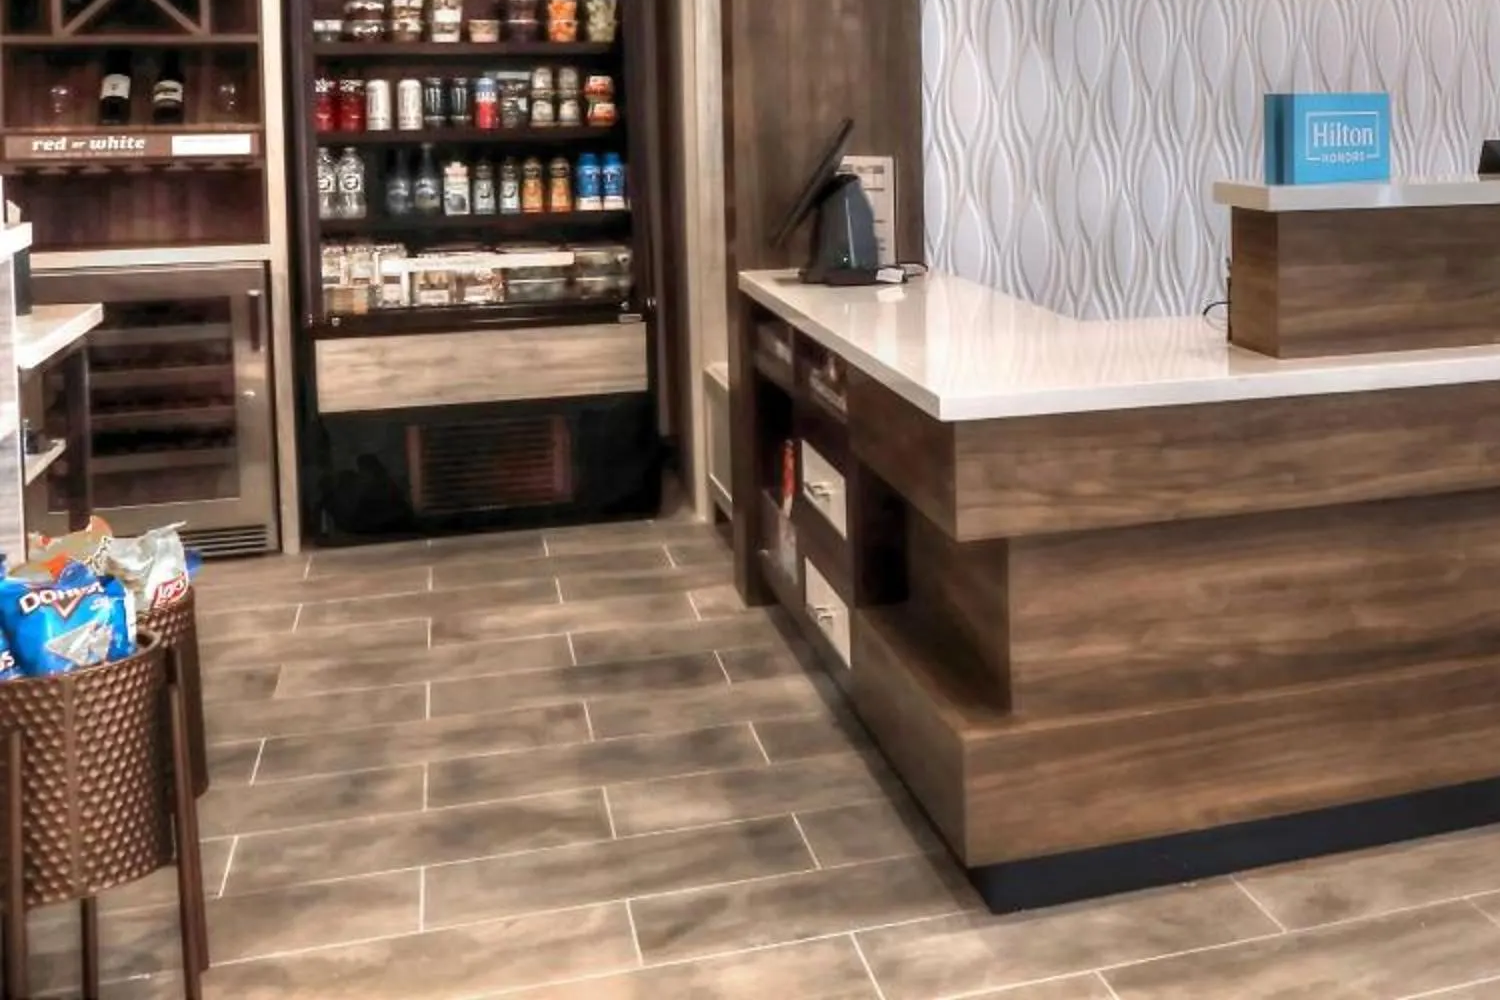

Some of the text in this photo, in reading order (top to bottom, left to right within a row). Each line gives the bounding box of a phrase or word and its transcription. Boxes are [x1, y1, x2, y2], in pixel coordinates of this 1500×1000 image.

[32, 136, 67, 151] red
[90, 135, 145, 150] white
[1313, 121, 1373, 148] Hilton
